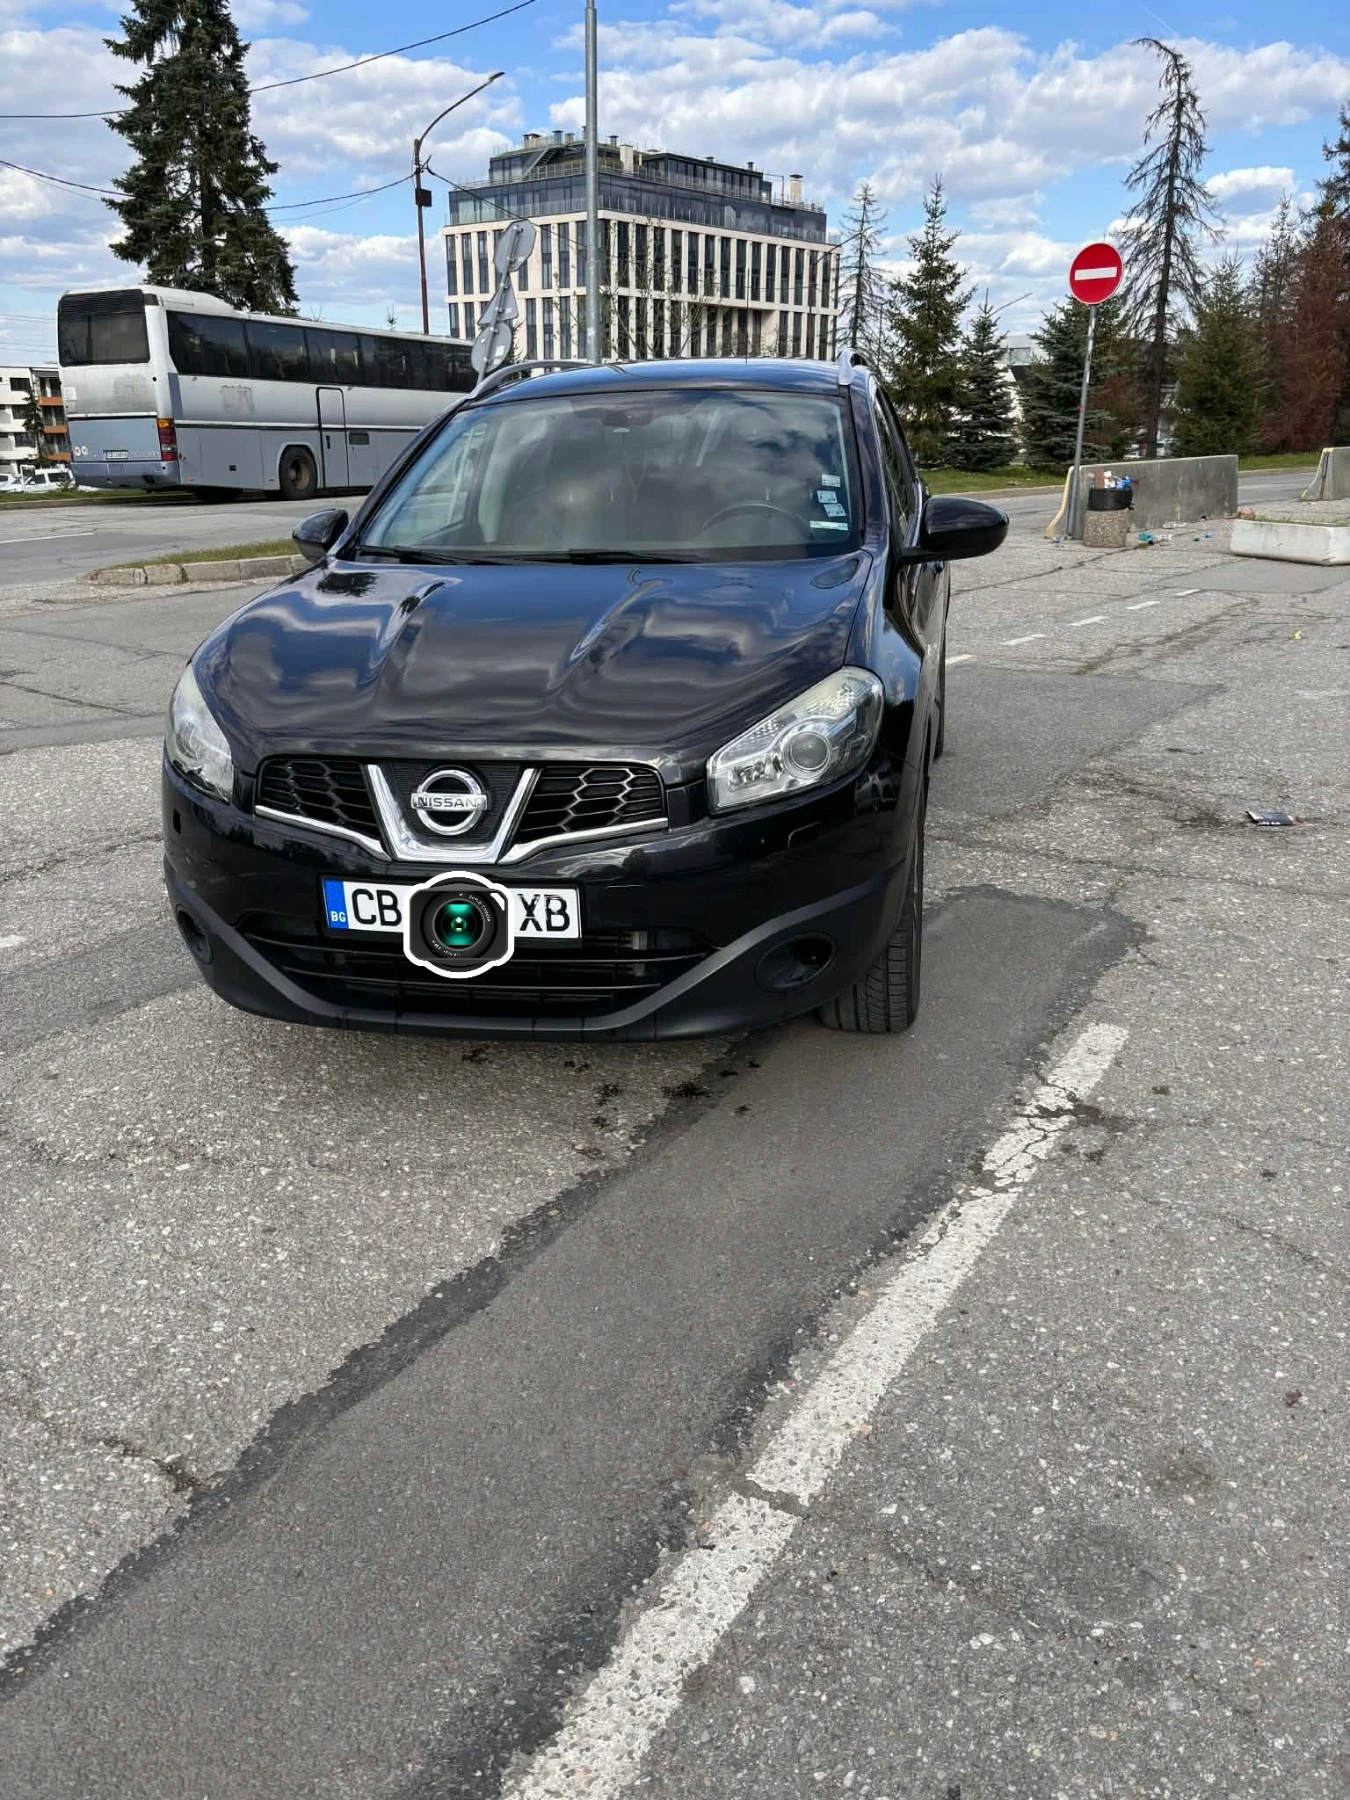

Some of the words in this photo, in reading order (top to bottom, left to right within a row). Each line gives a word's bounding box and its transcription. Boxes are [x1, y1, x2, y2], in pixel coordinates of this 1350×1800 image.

[416, 796, 478, 808] NISSAN
[351, 888, 402, 927] CB
[517, 893, 570, 932] XB
[331, 911, 346, 923] BG
